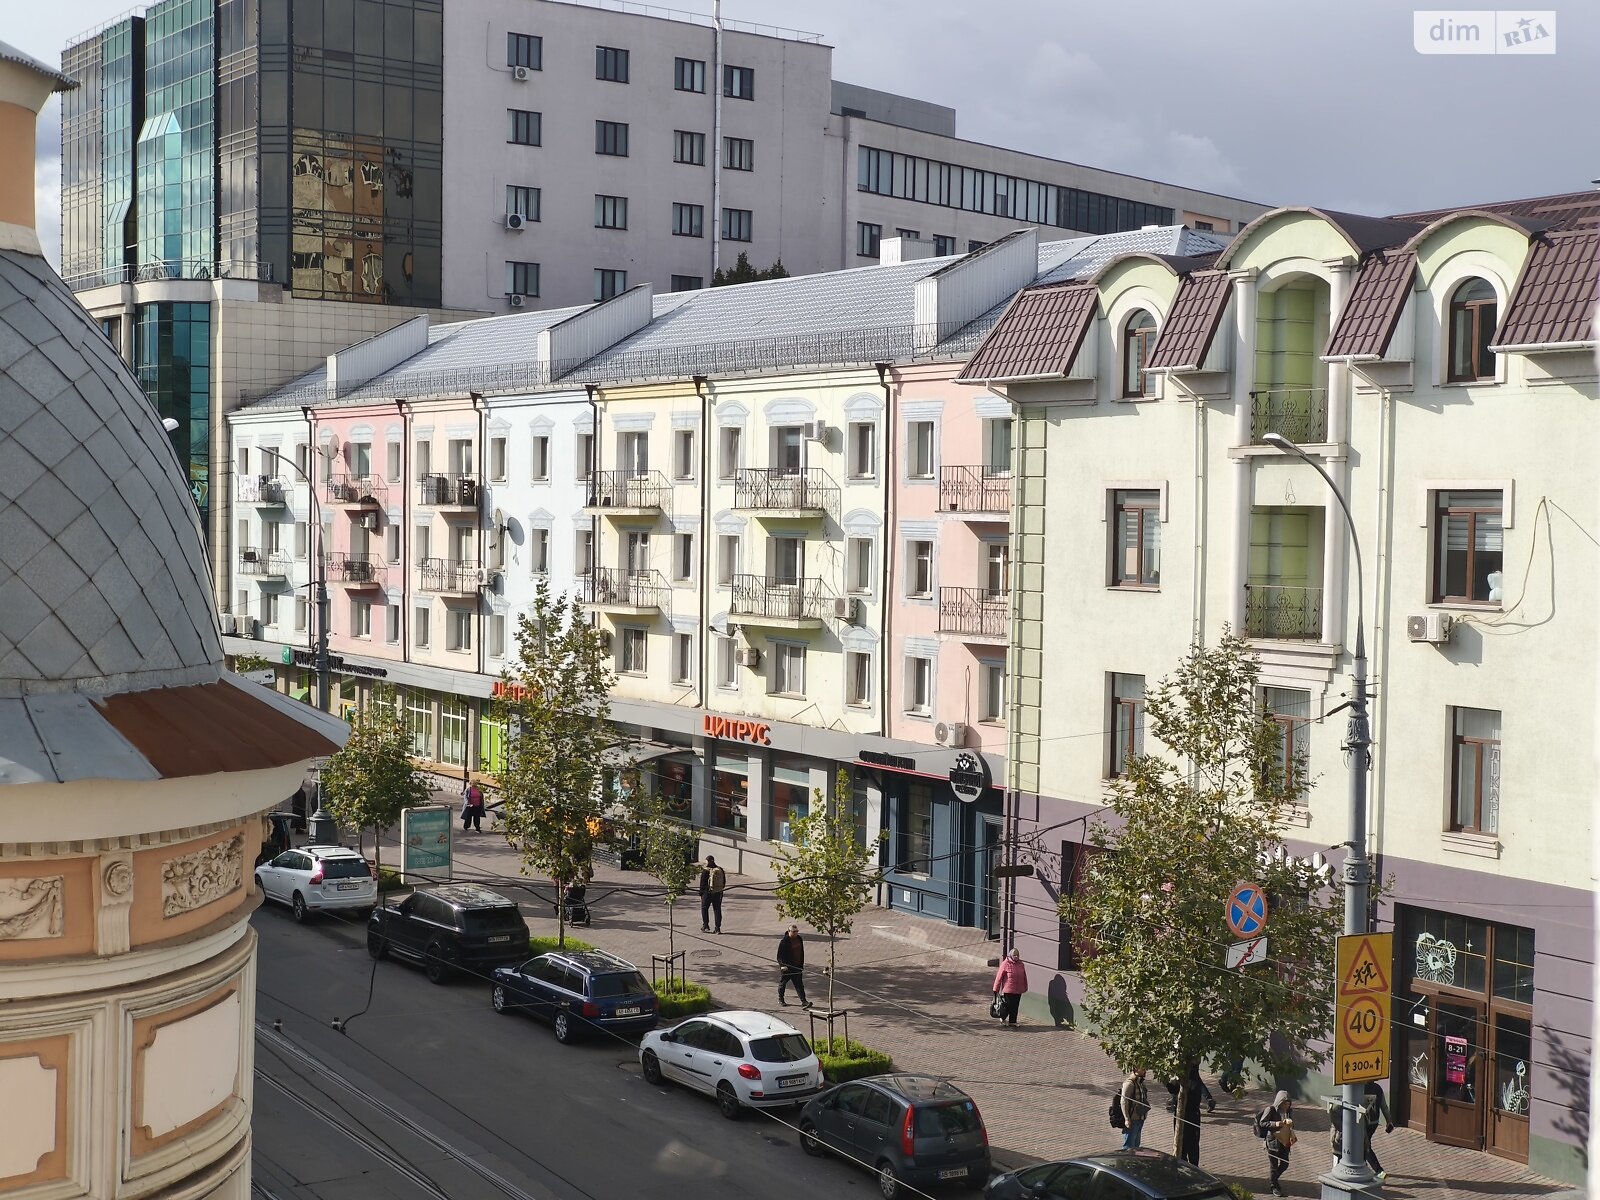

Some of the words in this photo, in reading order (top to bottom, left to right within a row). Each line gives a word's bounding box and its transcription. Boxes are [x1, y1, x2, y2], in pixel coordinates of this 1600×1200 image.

[704, 714, 771, 746] ЦИТРУС
[1349, 1008, 1377, 1034] 40
[1448, 1045, 1463, 1053] 8-21
